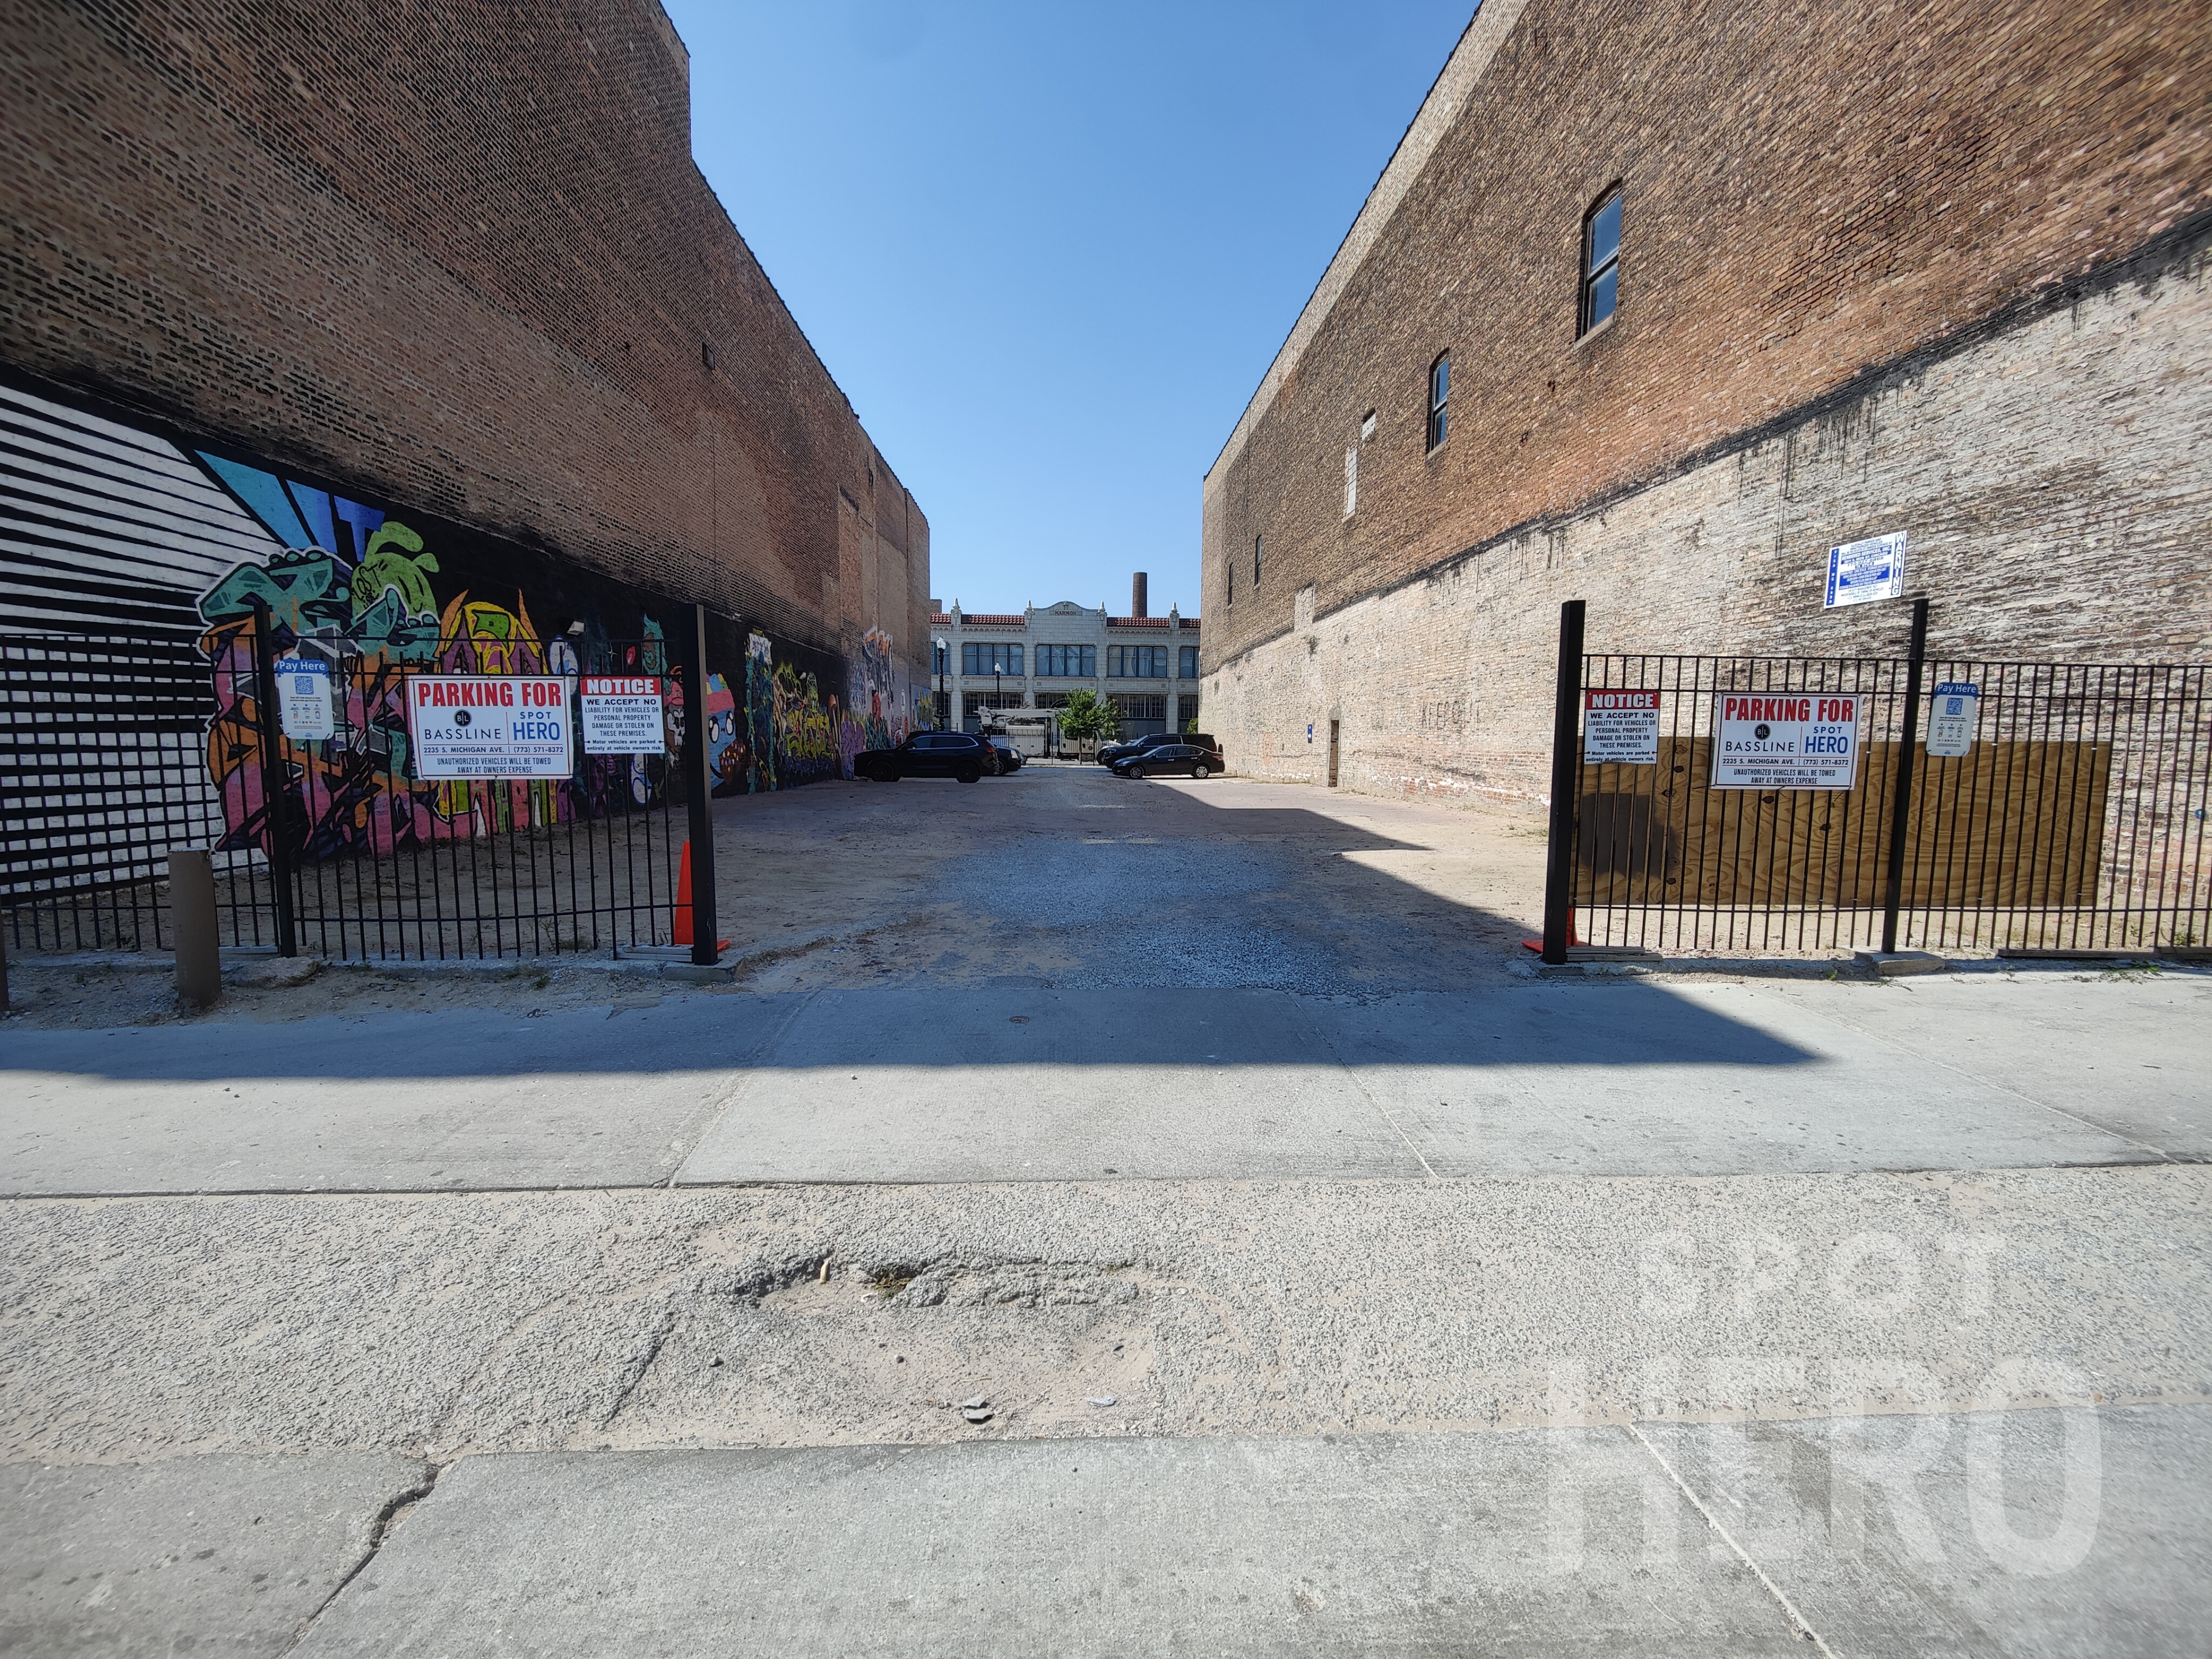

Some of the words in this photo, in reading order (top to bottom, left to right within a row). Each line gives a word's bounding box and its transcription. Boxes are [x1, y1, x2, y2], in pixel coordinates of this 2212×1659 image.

[1891, 533, 1905, 595] WARNING
[279, 661, 297, 672] Pay
[301, 662, 325, 670] Here
[587, 679, 654, 694] NOTICE
[1937, 684, 1953, 694] Pay
[418, 683, 513, 707] PARKING
[521, 683, 561, 707] FOR
[1592, 694, 1653, 707] NOTICE
[1725, 698, 1810, 721] PARKING
[1817, 699, 1853, 722] FOR
[425, 729, 501, 740] BASSLINE
[513, 722, 560, 740] HERO
[1726, 741, 1794, 752] BASSLINE
[1805, 736, 1848, 753] HERO
